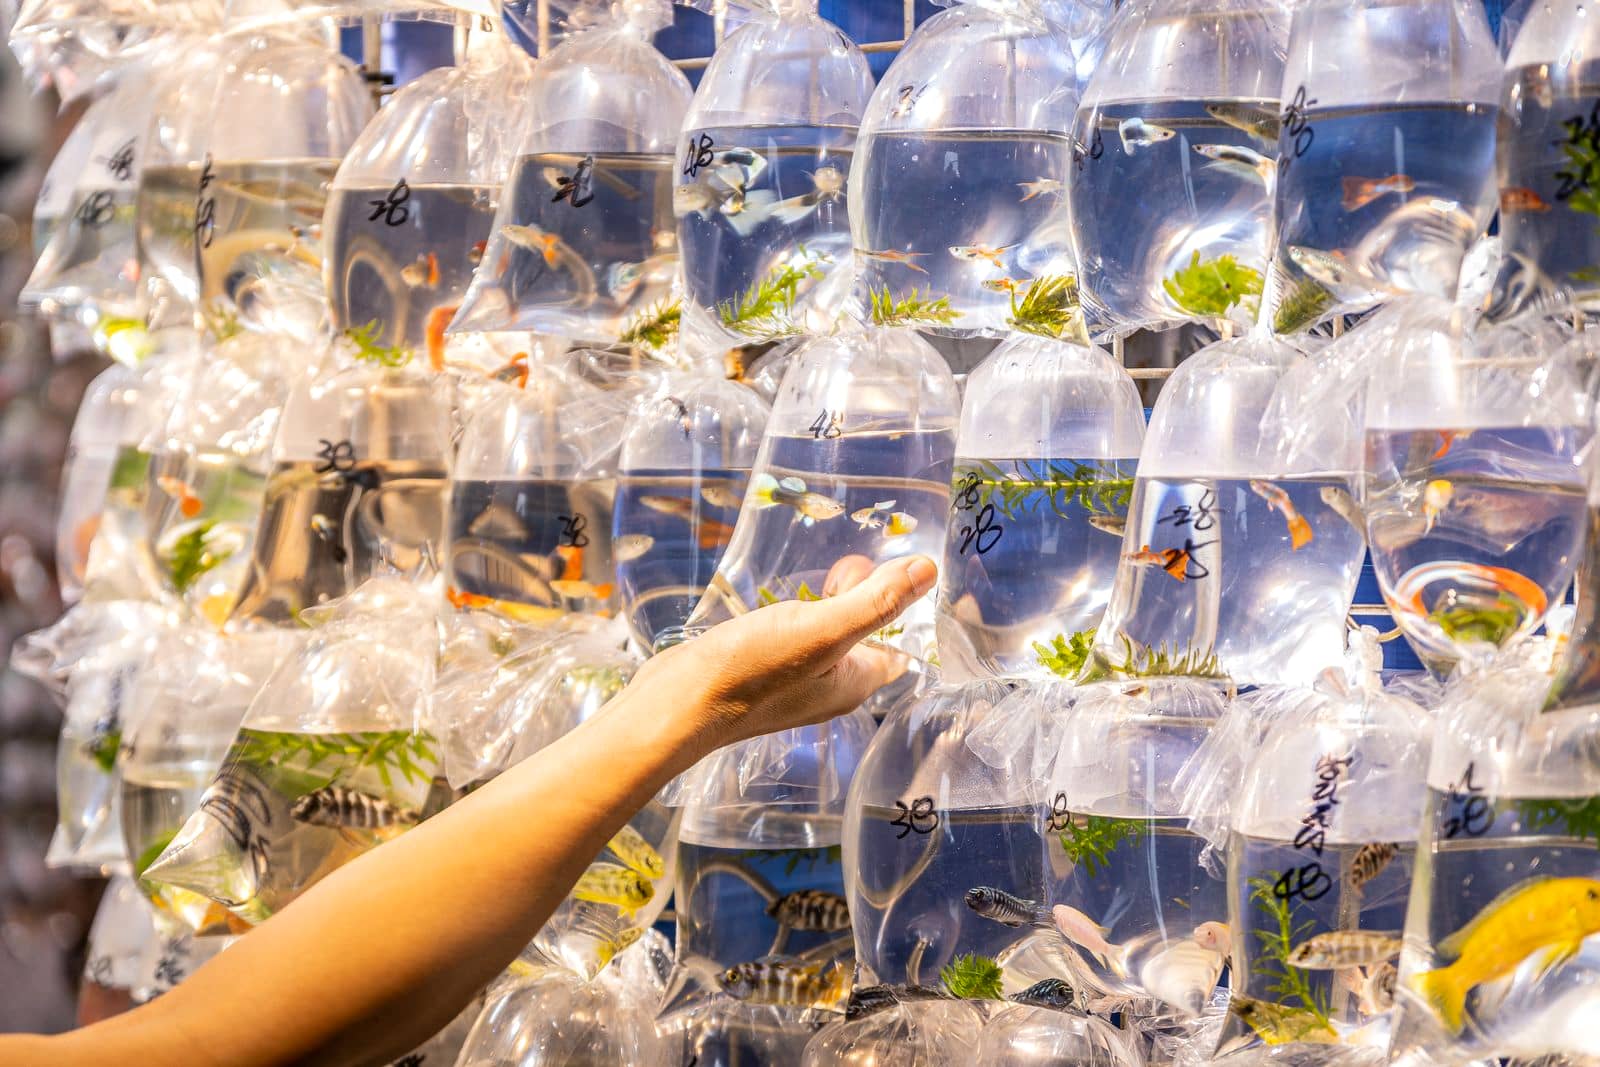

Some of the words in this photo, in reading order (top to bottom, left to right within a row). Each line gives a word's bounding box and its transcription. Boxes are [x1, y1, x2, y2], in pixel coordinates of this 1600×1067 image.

[369, 178, 410, 227] 28
[808, 408, 844, 439] 48
[960, 503, 1003, 556] 28
[890, 796, 938, 838] 38
[1273, 863, 1332, 901] 48
